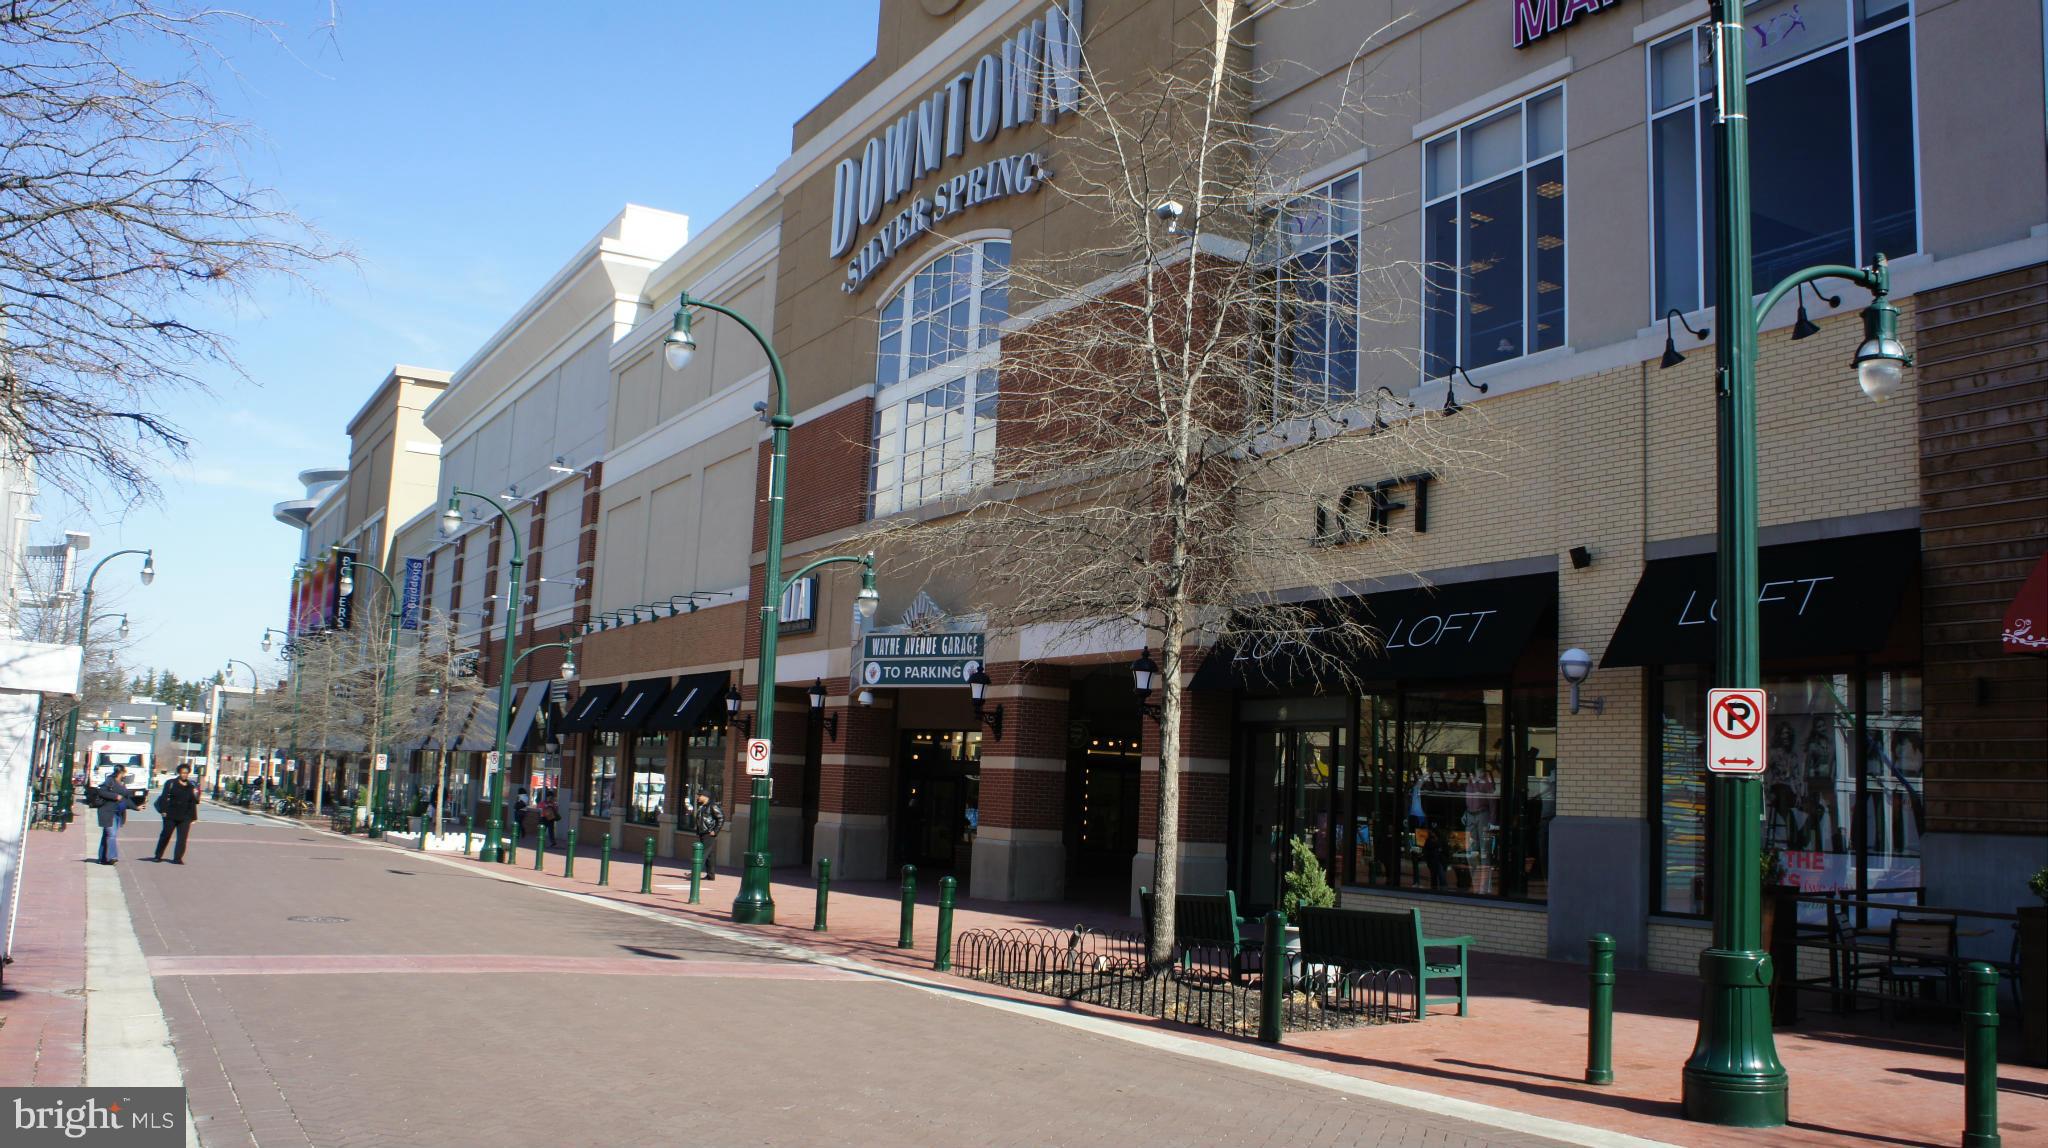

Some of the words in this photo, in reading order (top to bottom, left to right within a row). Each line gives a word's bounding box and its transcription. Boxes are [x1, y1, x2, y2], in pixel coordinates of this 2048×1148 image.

[830, 0, 1082, 259] DOWNTOWN
[846, 197, 932, 294] SILVER
[933, 152, 1043, 223] SPRING
[1310, 471, 1437, 548] LOFT
[1678, 576, 1834, 625] LFT
[872, 637, 901, 656] WAYNE
[904, 636, 938, 655] AVENUE
[941, 635, 979, 655] GARAGE
[1233, 626, 1324, 661] LOFT
[1386, 610, 1497, 649] LOFT
[883, 666, 901, 678] TO
[904, 666, 962, 679] PARKING
[1785, 850, 1825, 871] THE
